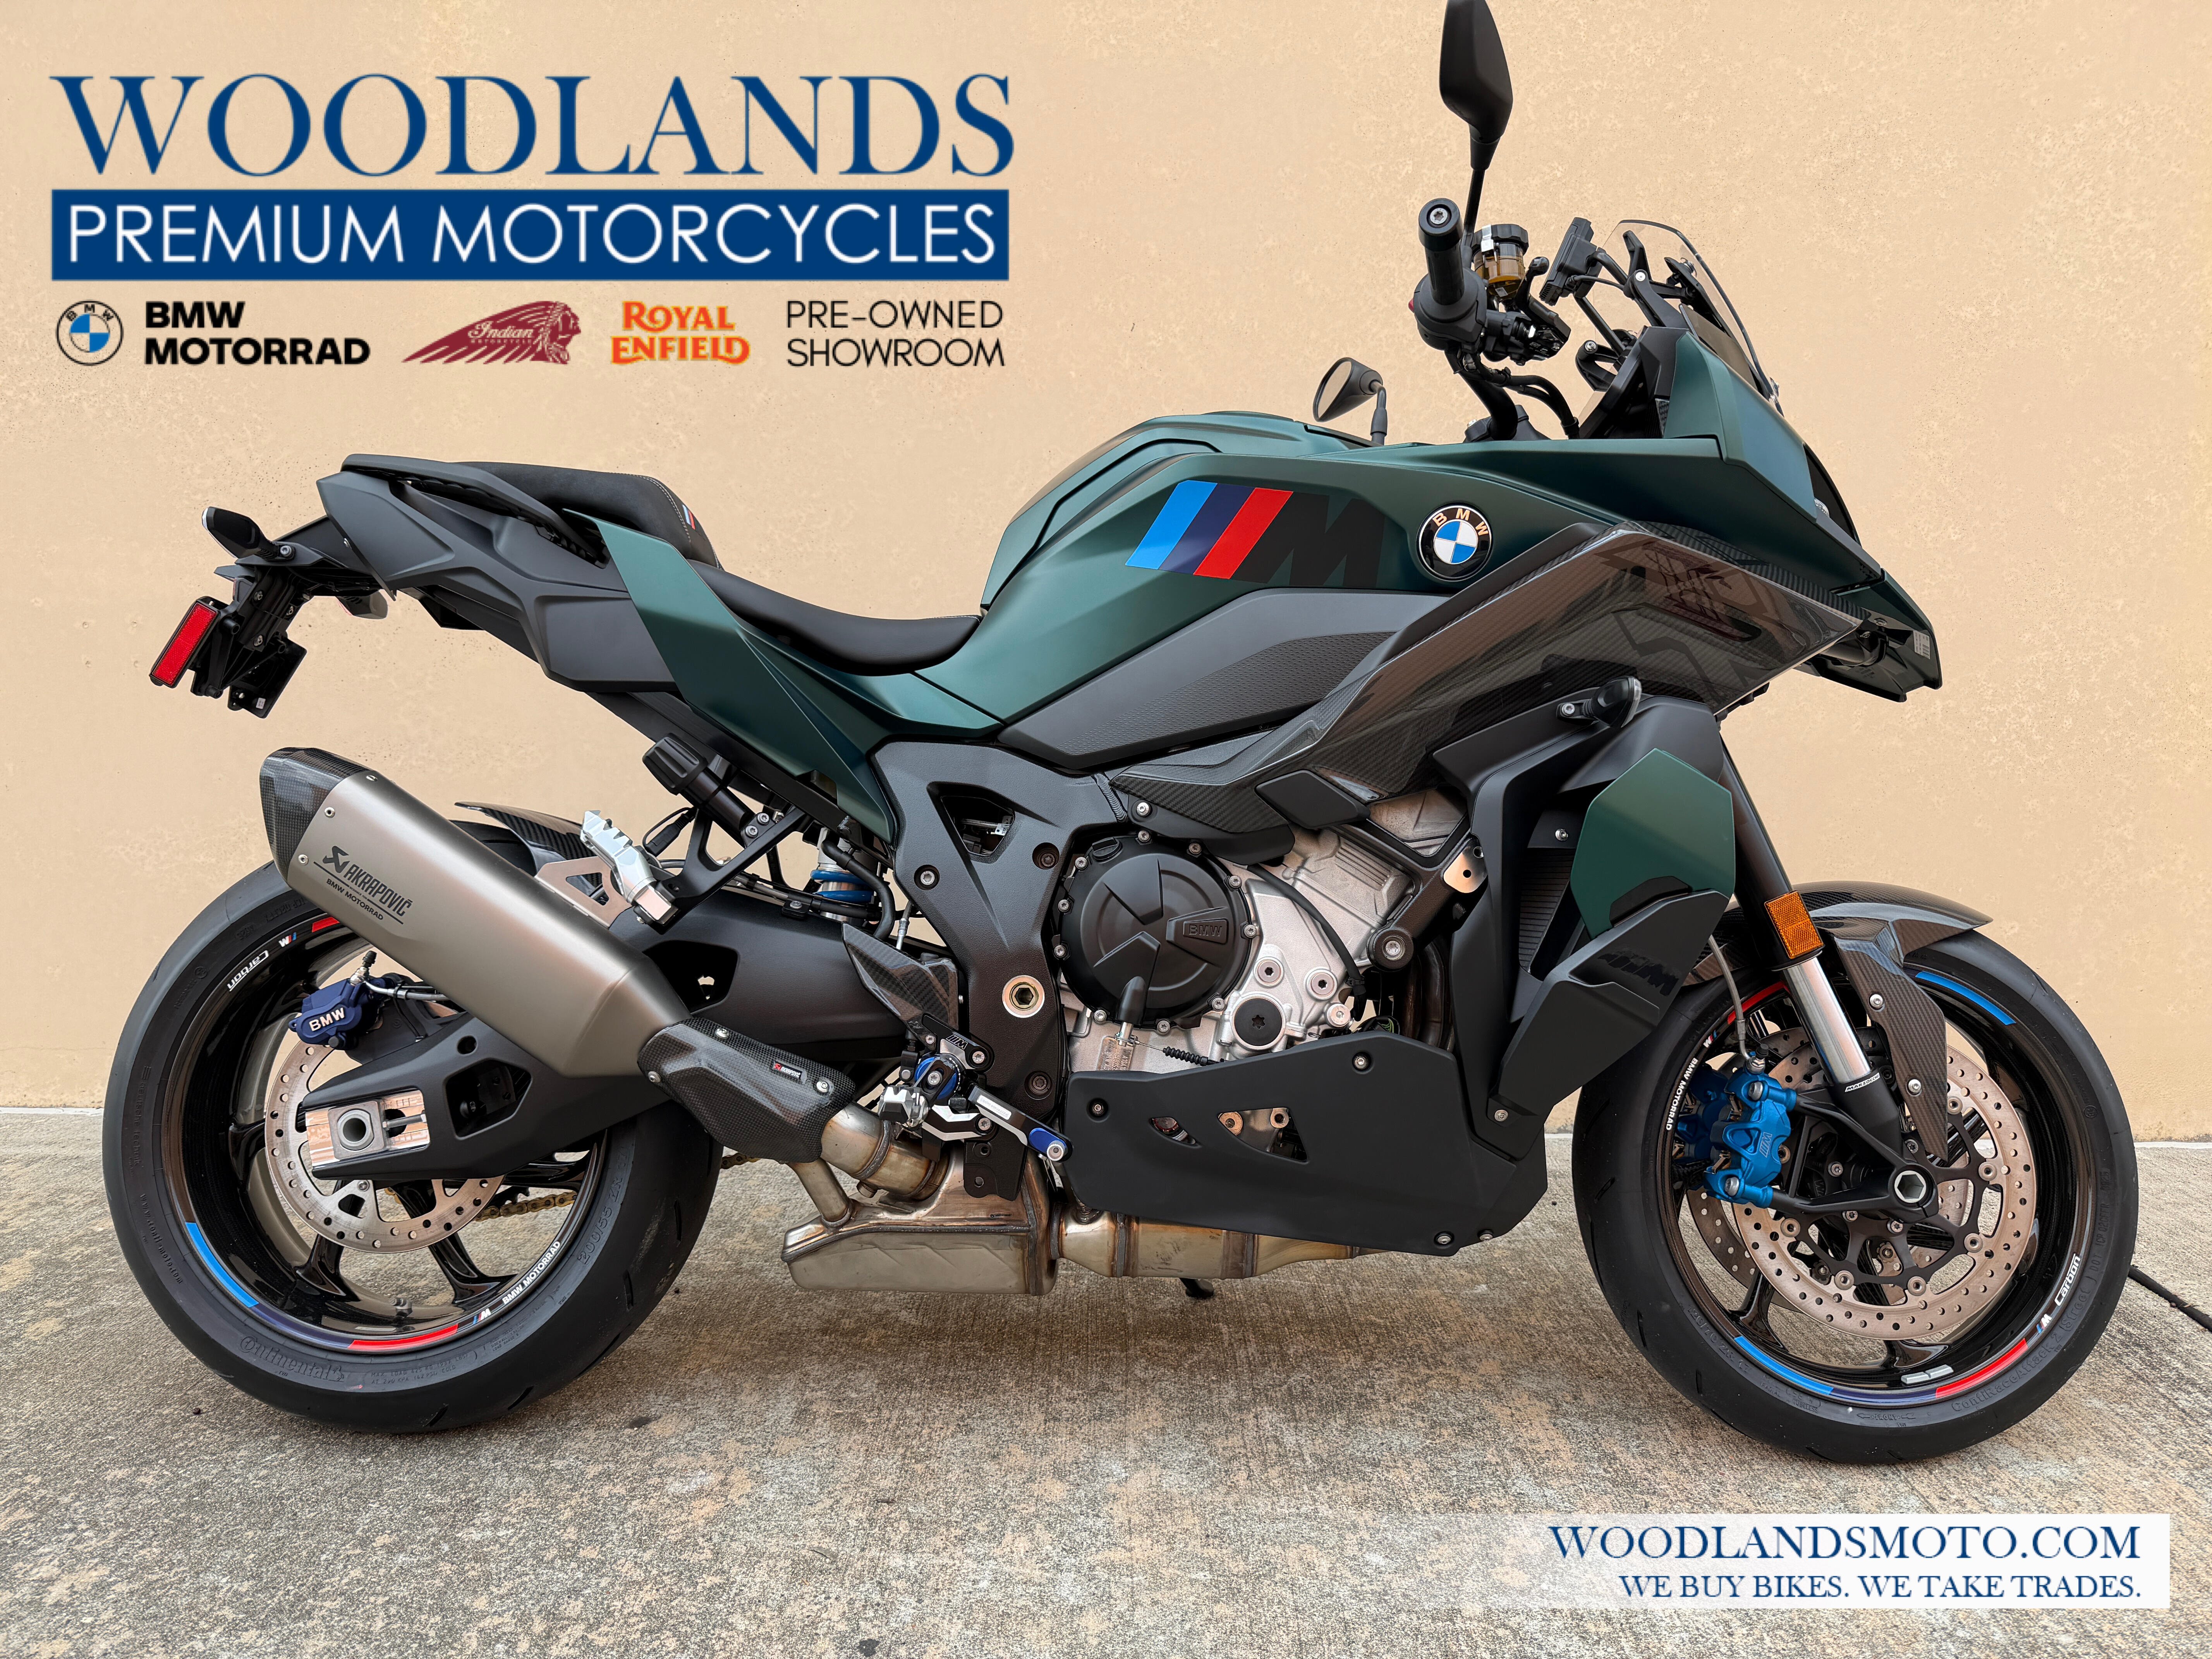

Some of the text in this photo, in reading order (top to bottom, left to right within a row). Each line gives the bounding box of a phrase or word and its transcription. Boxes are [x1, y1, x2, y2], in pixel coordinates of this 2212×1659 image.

[1432, 508, 1489, 536] BMW
[326, 878, 384, 921] BMW MOTORRAD
[343, 864, 413, 917] AKRAPOVIČ
[1188, 924, 1223, 937] BMW
[227, 950, 270, 991] Carbon
[308, 1007, 346, 1032] BMW
[1666, 1057, 1699, 1131] BMW MOTORRAD
[577, 1206, 613, 1265] 200/55
[502, 1284, 523, 1305] BMW
[522, 1241, 561, 1287] MOTORRAD
[2054, 1253, 2081, 1307] Carbon
